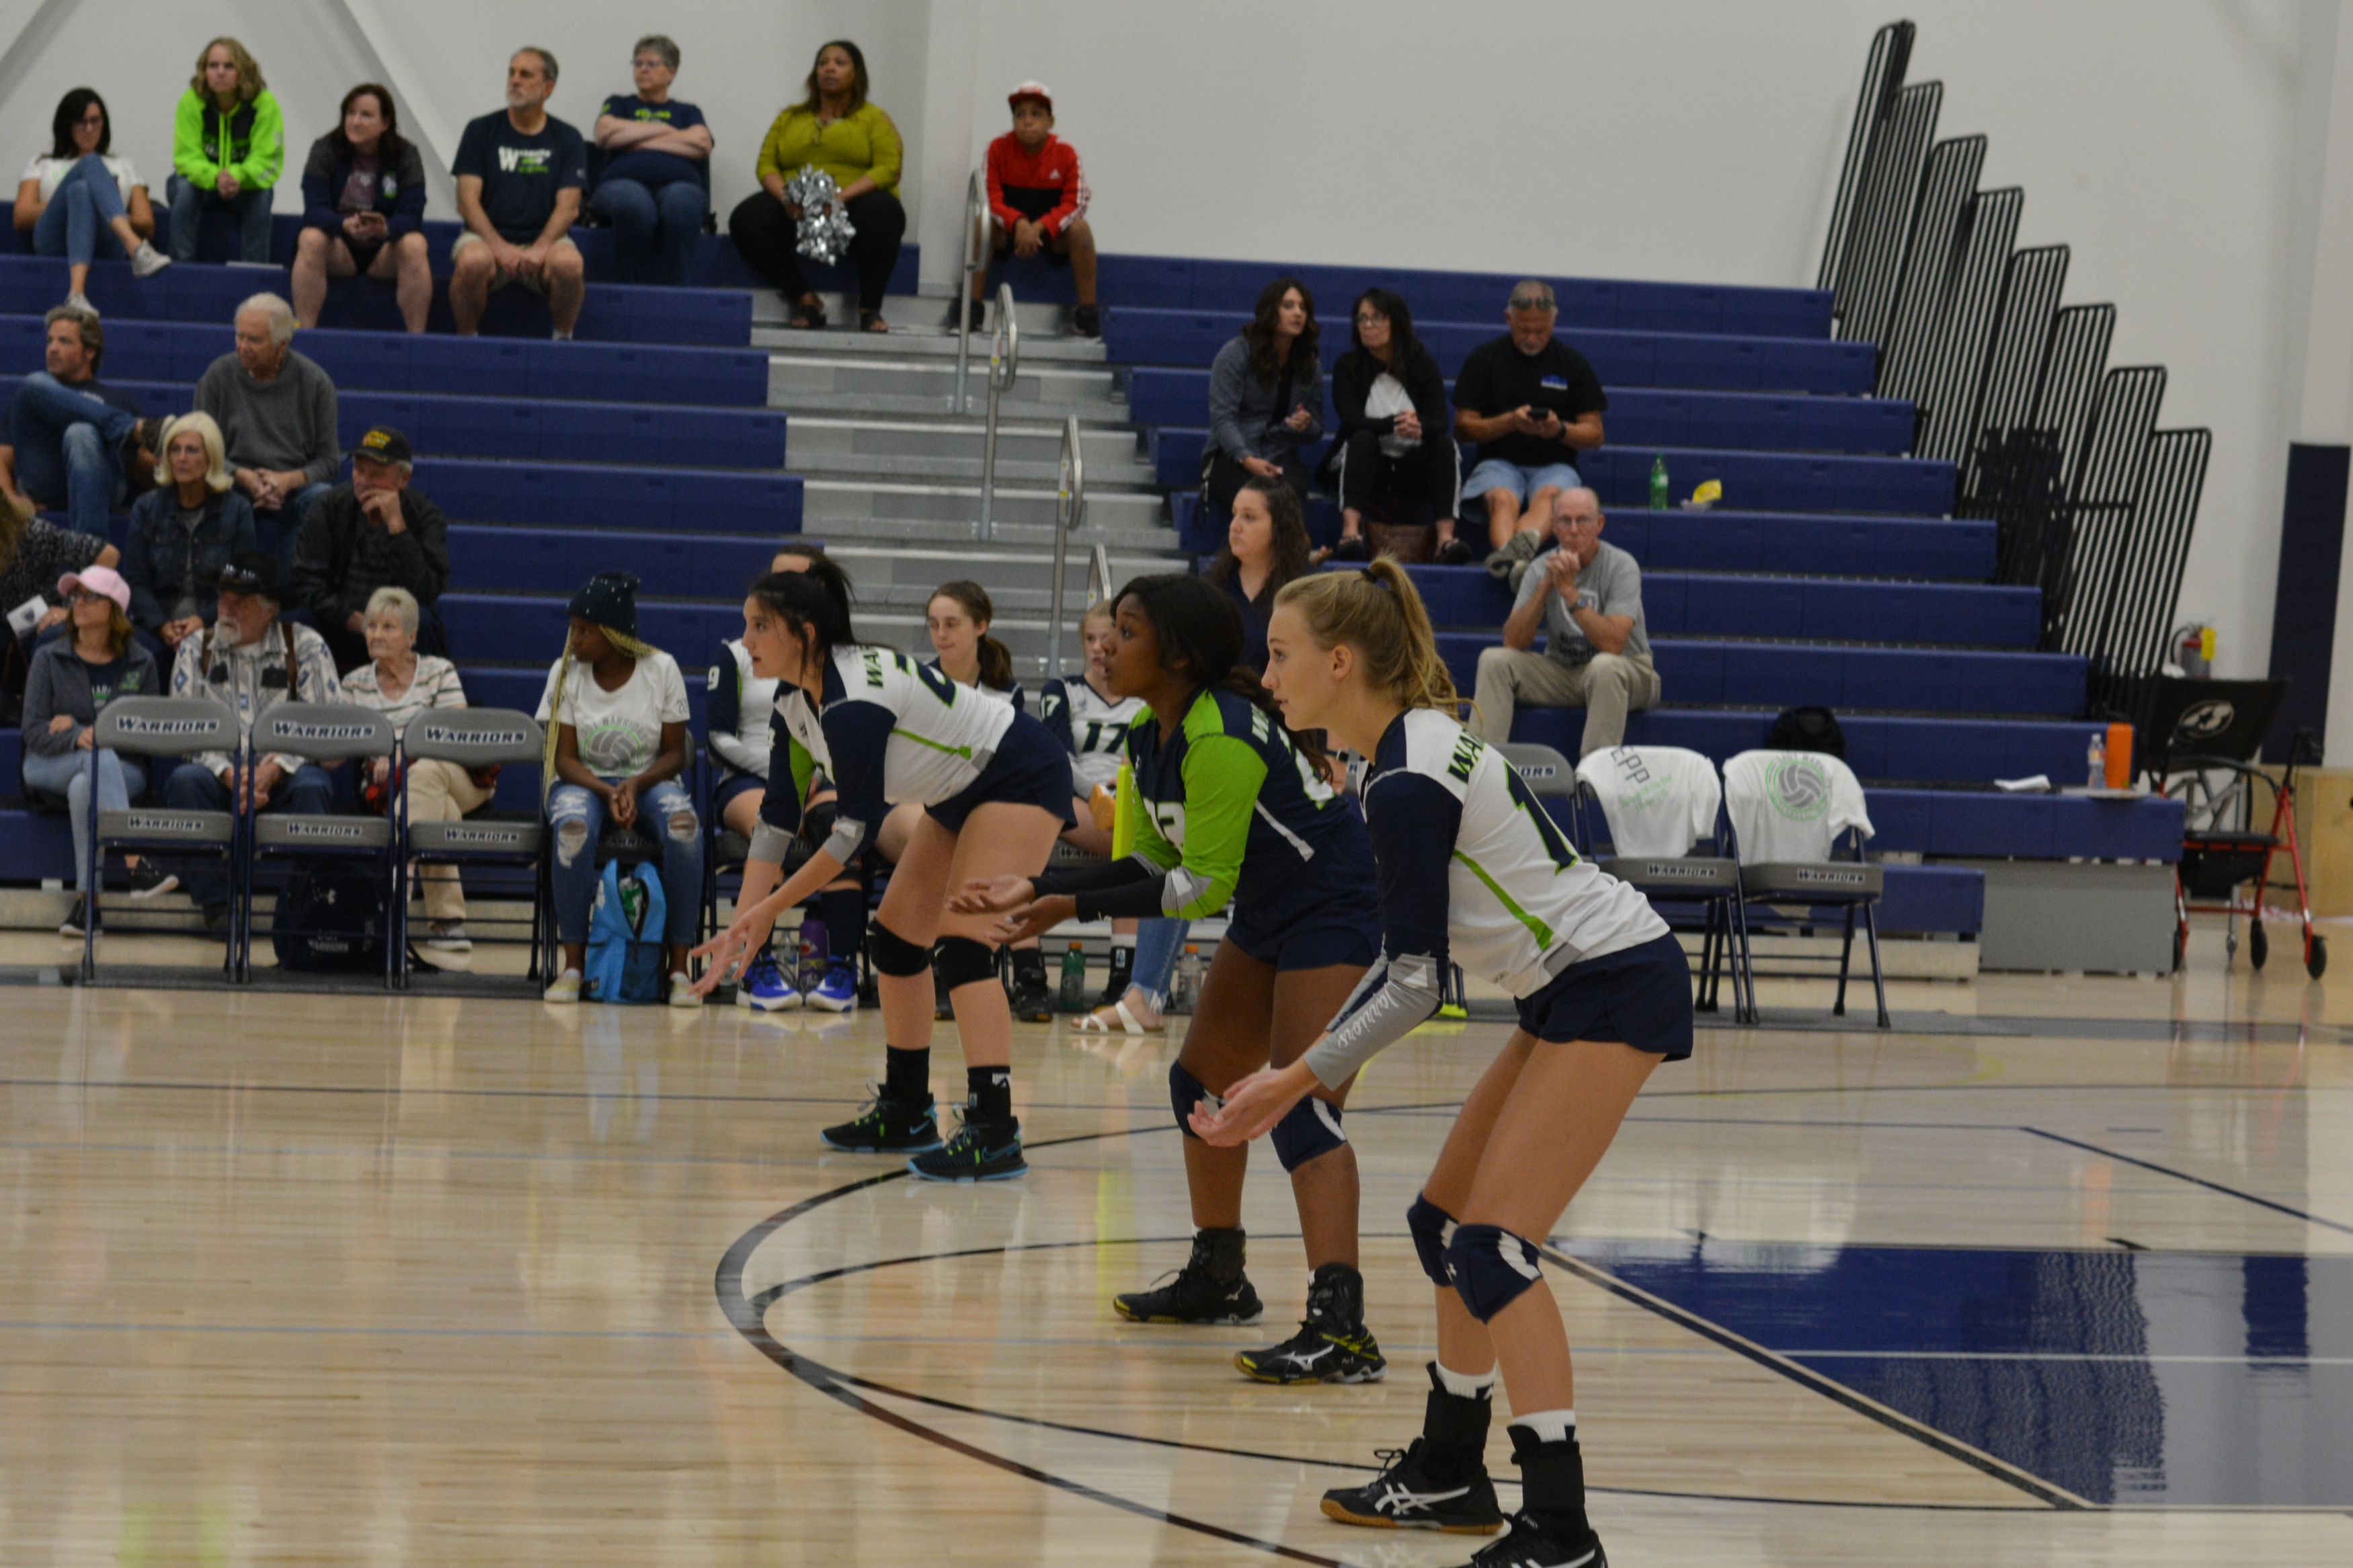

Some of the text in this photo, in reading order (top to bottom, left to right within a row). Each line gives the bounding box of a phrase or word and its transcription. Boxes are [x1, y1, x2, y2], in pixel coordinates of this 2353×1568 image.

[1041, 694, 1061, 719] 17
[116, 715, 220, 734] WARRIORS
[273, 719, 376, 738] WARRIORS
[425, 725, 526, 744] WARRIORS
[1080, 721, 1130, 753] 17
[1516, 765, 1556, 779] ORS
